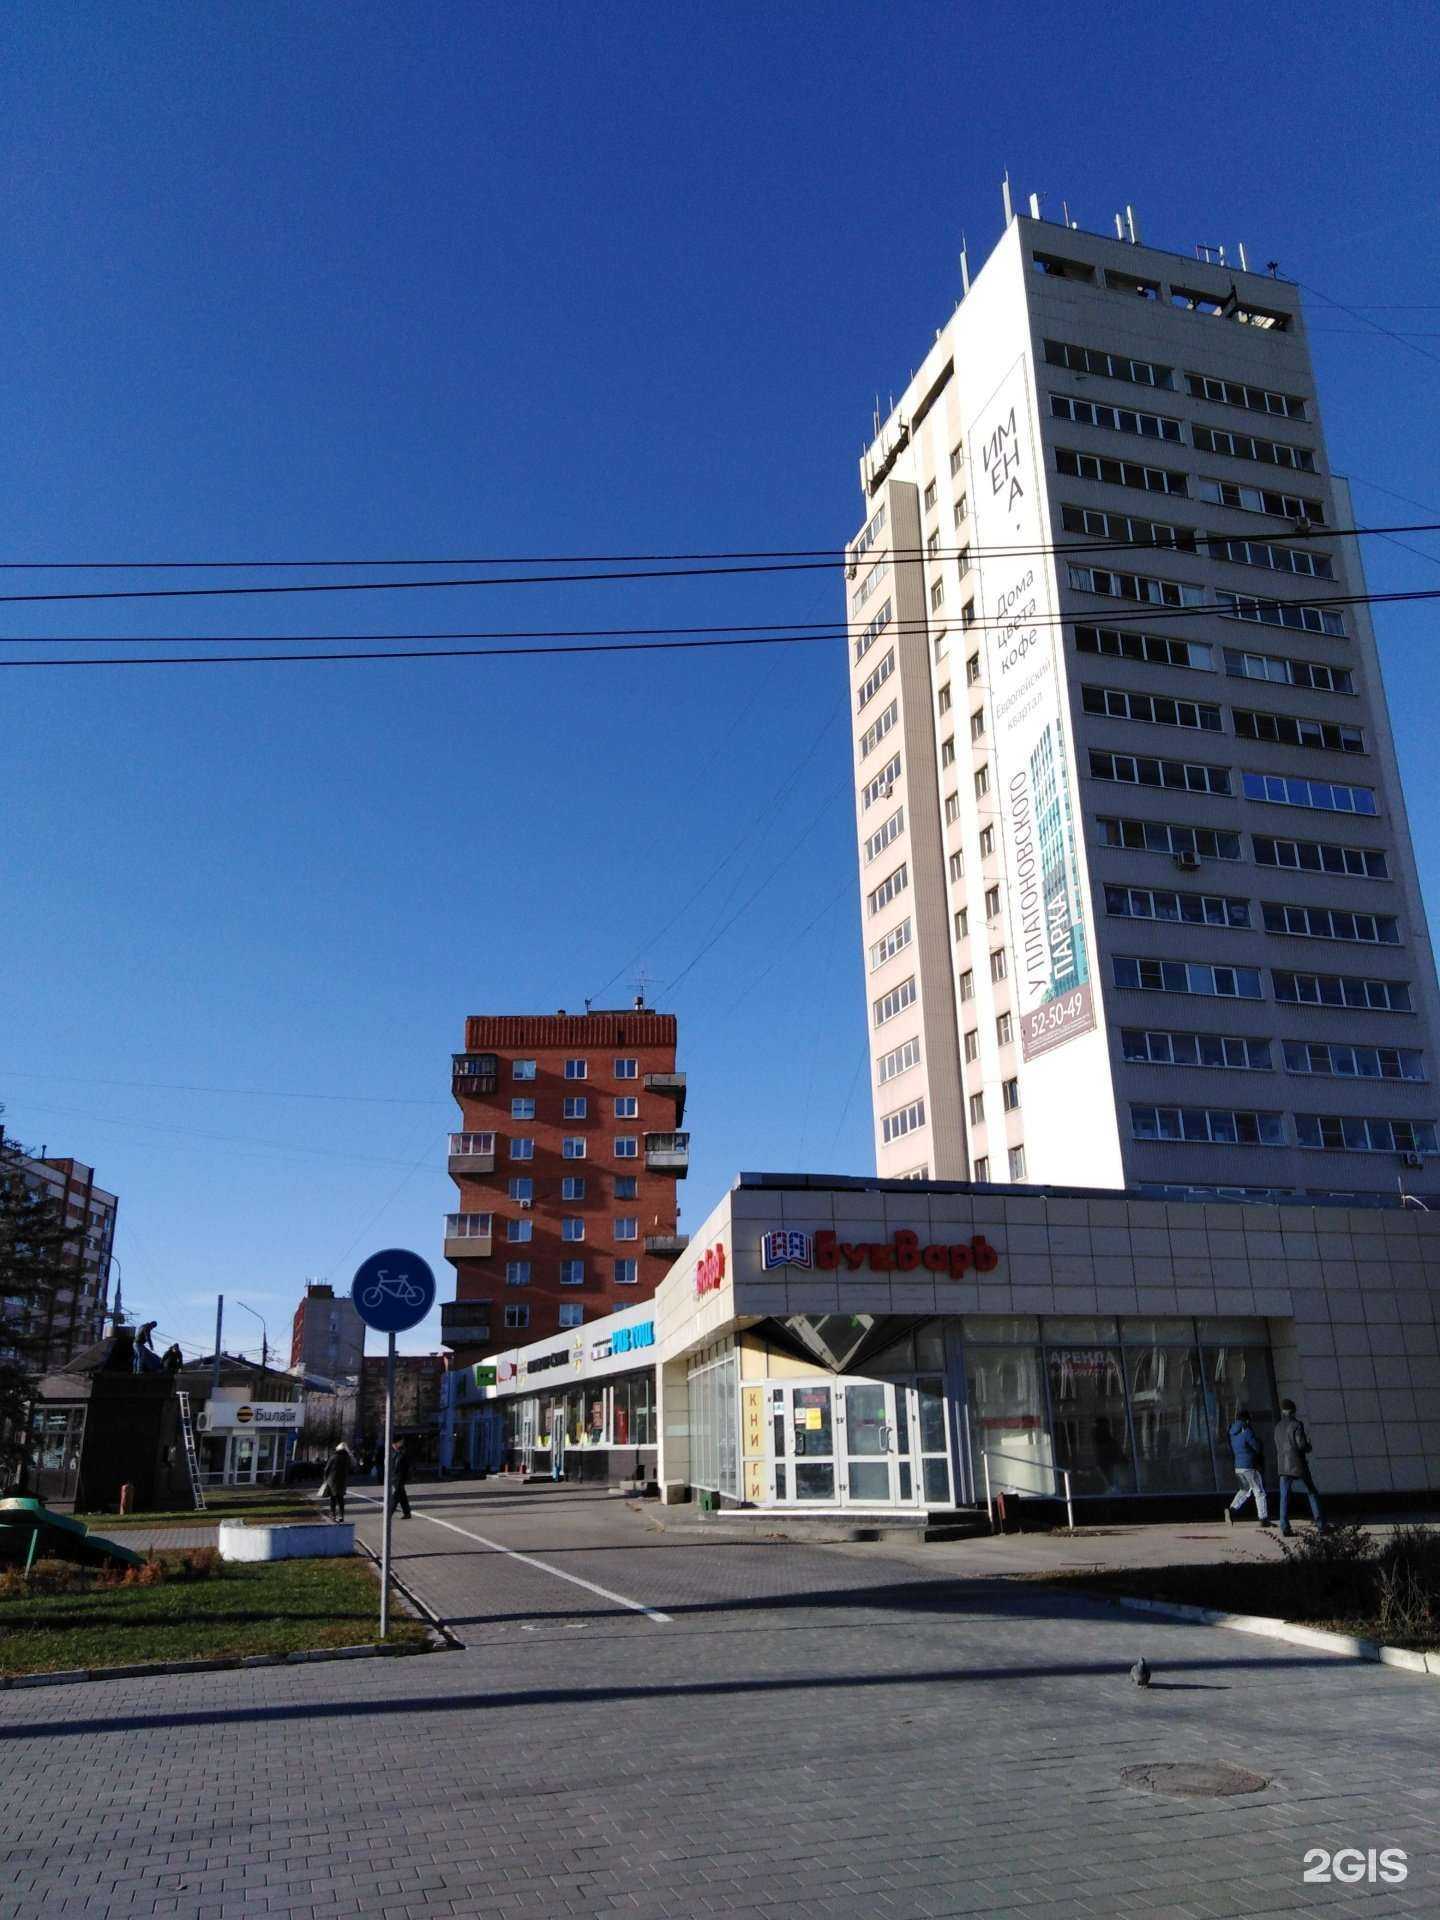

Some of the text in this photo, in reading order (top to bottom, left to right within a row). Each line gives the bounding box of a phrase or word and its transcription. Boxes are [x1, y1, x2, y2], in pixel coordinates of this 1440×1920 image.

[997, 569, 1034, 624] Дома
[998, 598, 1037, 648] цвета
[1002, 628, 1038, 674] кофе
[1007, 692, 1043, 731] квартал
[1009, 771, 1047, 995] У ПЛАТОНОВСКОГО
[1047, 890, 1074, 979] ПАРКА
[1031, 992, 1083, 1037] 52-50-49
[255, 1408, 297, 1423] Билайн
